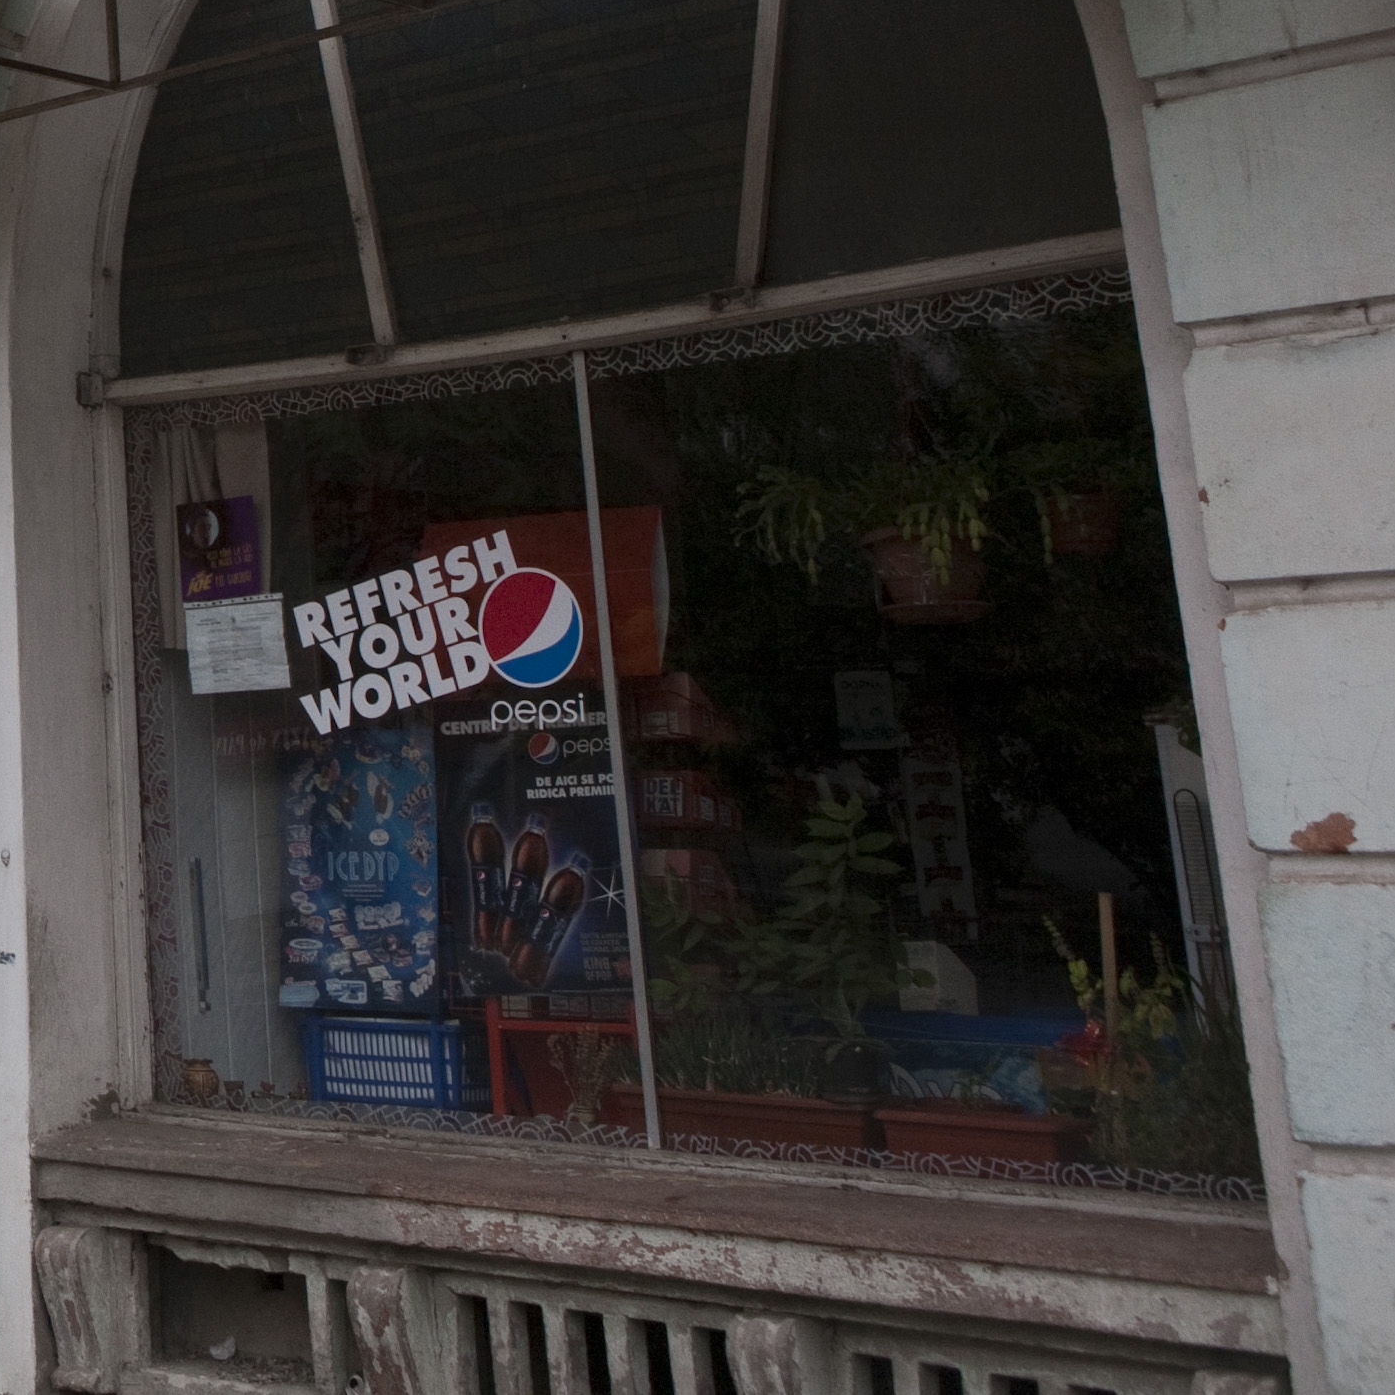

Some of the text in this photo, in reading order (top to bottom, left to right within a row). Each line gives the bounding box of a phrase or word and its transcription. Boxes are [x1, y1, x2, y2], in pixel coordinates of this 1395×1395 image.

[293, 529, 518, 649] REFRESH
[319, 596, 480, 682] YOUR
[298, 640, 491, 736] WORLD
[490, 692, 586, 731] pepsi
[562, 737, 611, 758] peps
[526, 787, 567, 799] RIDICA
[535, 773, 615, 787] DE AICI SE PO
